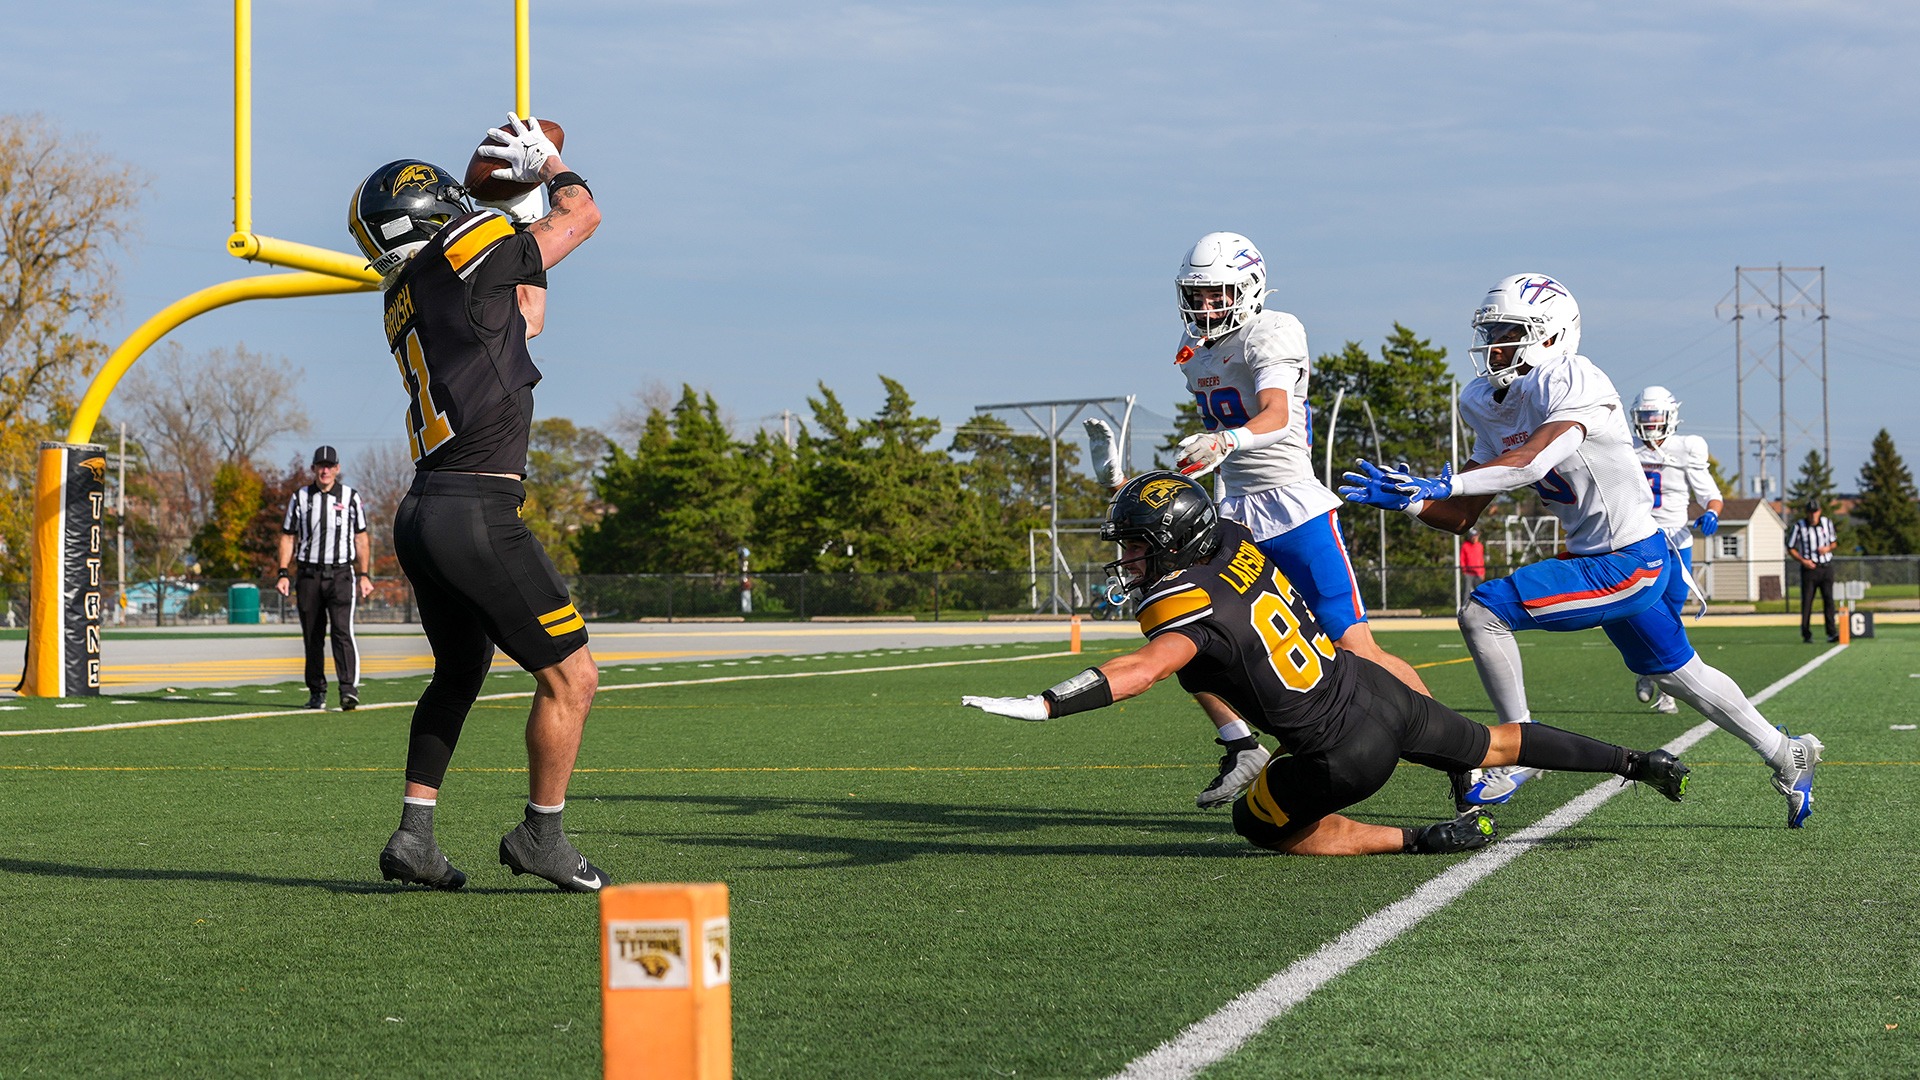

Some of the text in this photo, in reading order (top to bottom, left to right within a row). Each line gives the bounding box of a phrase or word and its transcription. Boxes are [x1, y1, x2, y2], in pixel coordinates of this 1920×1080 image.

[384, 283, 414, 346] BRUSH
[394, 326, 456, 463] 11
[85, 491, 102, 688] TITANS
[1218, 539, 1266, 595] LARSON
[1250, 566, 1337, 694] 83
[1850, 612, 1866, 636] G
[1791, 747, 1807, 770] NIKE
